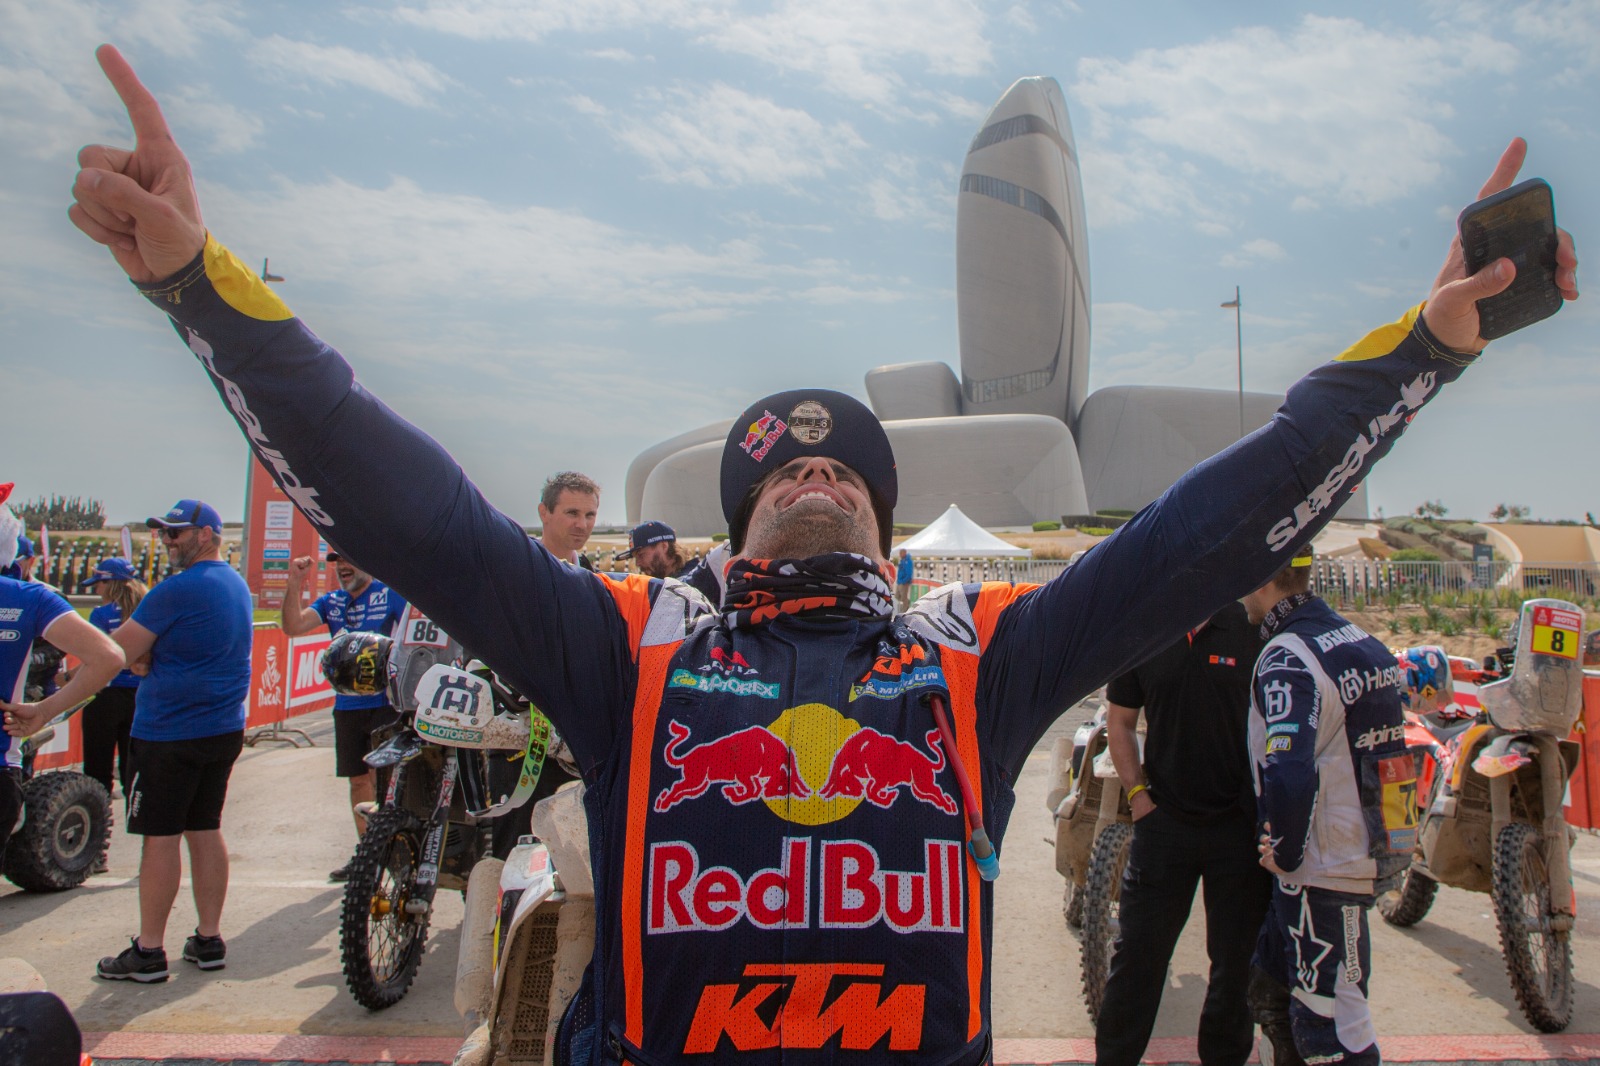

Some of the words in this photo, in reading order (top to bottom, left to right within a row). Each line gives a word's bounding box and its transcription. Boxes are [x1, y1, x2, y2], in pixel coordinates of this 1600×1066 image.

[751, 437, 774, 462] Red
[766, 419, 788, 443] Bull
[413, 620, 439, 642] 86
[1551, 630, 1565, 653] 8
[428, 724, 480, 742] MOTOREX
[647, 836, 812, 935] Red
[819, 838, 964, 933] Bull
[683, 963, 926, 1054] KTM
